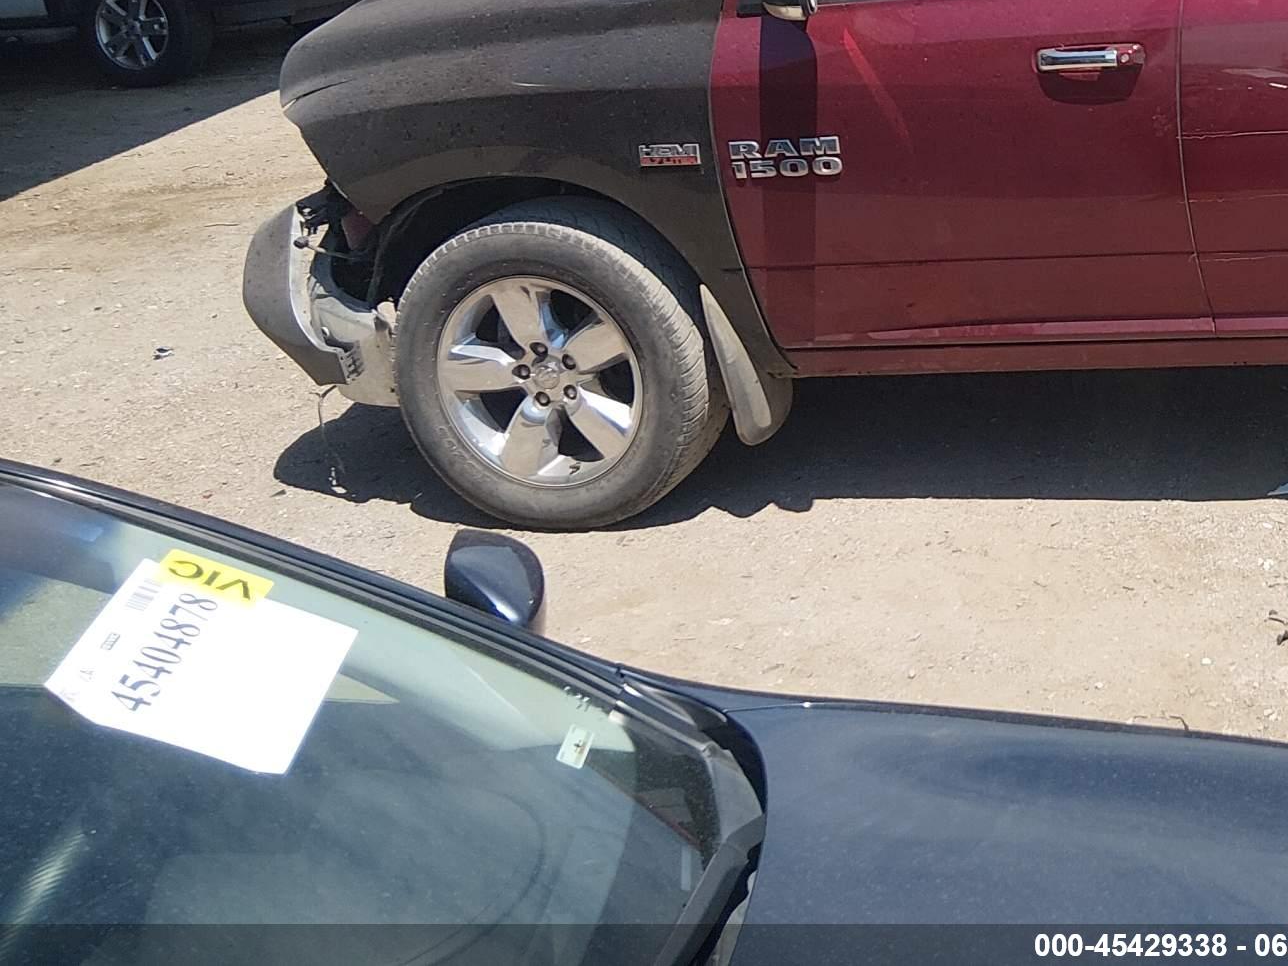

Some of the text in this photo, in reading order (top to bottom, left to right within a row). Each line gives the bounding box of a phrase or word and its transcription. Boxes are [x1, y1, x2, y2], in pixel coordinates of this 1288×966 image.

[728, 135, 842, 159] RAM
[731, 156, 843, 179] 1500
[168, 559, 252, 601] VIC
[111, 592, 218, 712] 45404878
